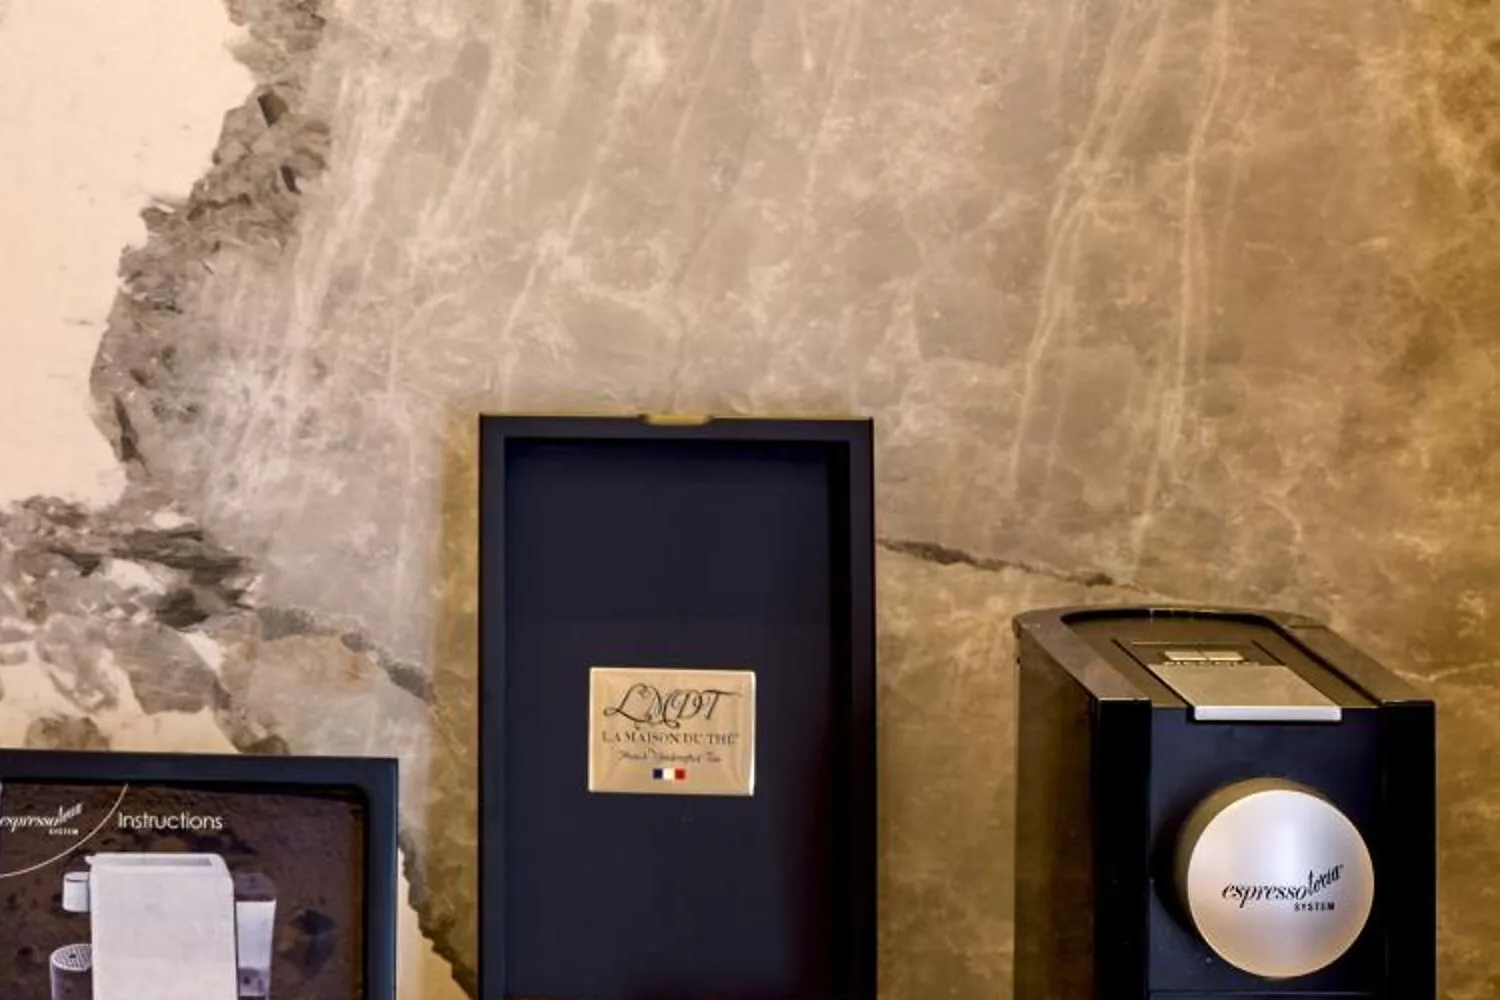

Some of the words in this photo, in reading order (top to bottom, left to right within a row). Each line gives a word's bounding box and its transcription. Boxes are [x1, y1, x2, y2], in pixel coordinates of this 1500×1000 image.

[601, 731, 621, 743] LA
[624, 731, 679, 745] MAISON
[117, 811, 223, 830] Instructions
[1293, 901, 1335, 912] SYSTEM
